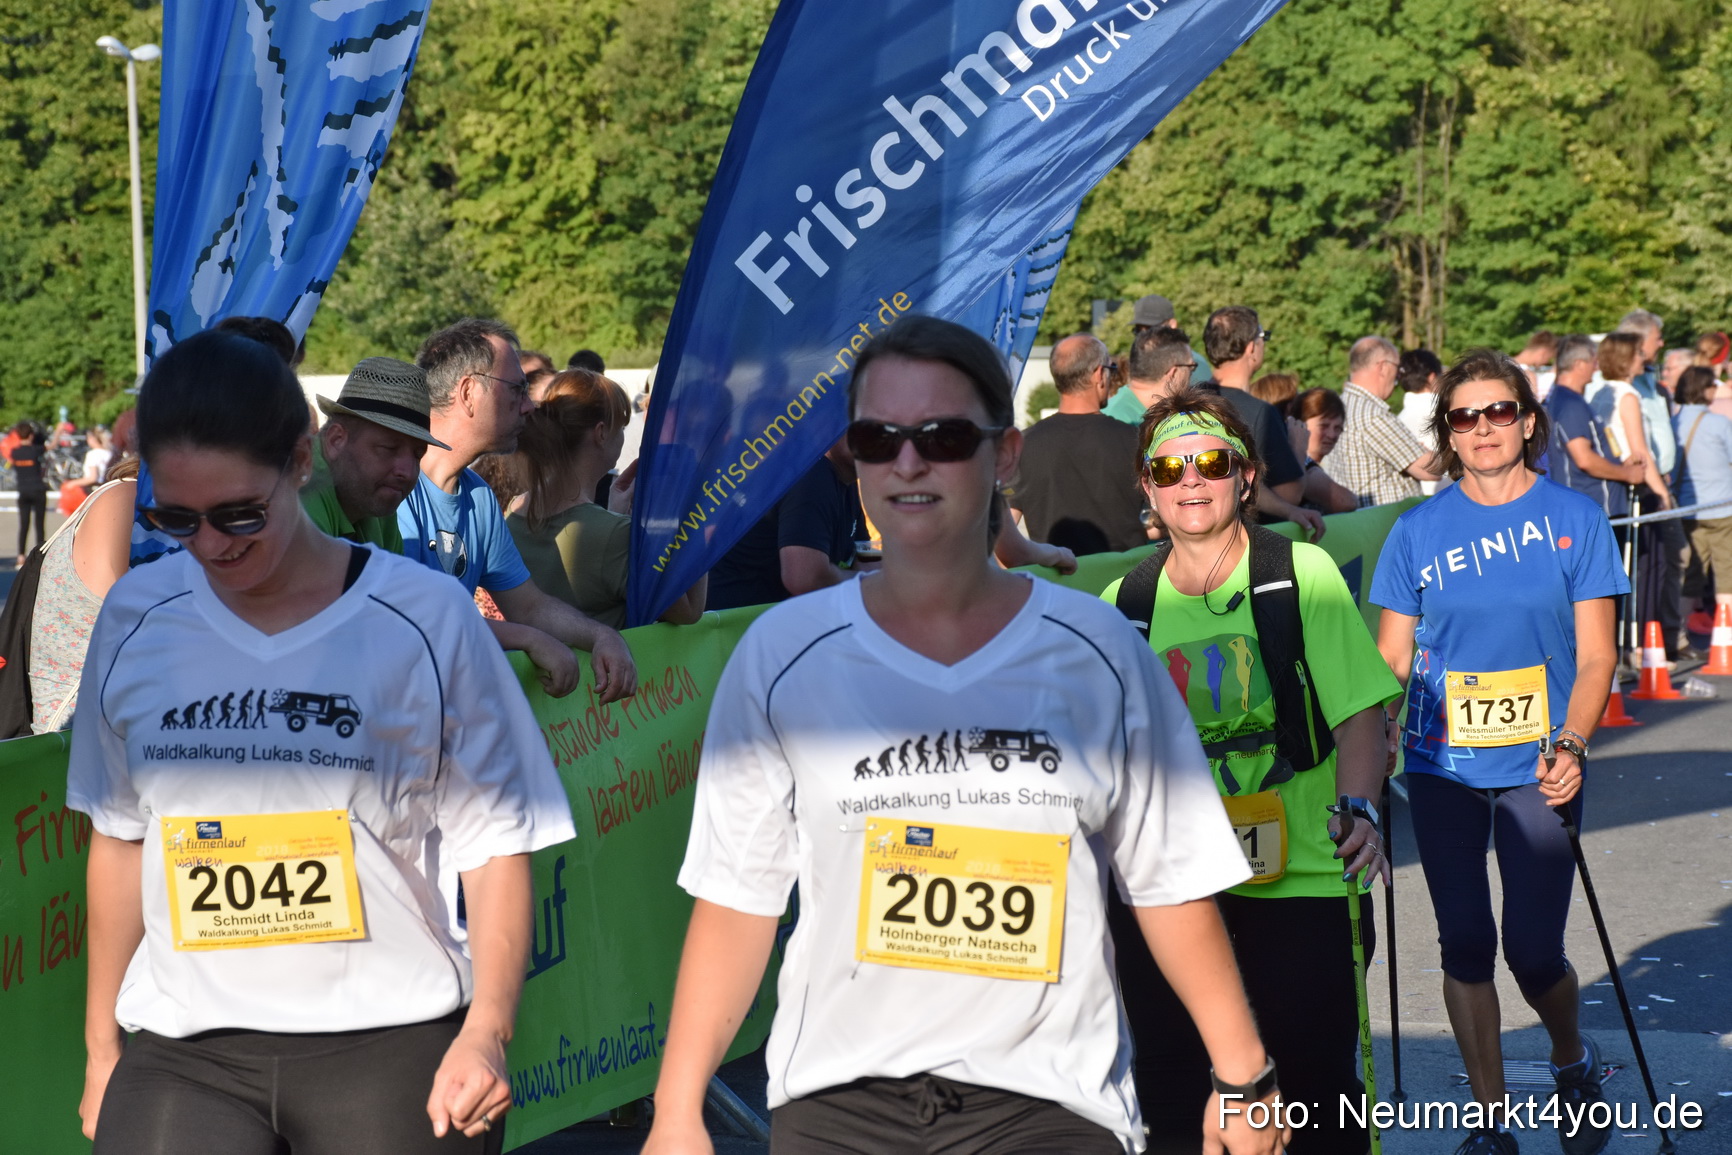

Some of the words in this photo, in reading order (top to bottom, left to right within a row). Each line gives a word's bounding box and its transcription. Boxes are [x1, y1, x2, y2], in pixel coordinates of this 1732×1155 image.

[1021, 20, 1131, 122] Druck
[1126, 0, 1168, 21] u
[734, 0, 1098, 315] Frischma
[652, 291, 912, 572] www.frischmann-net.de
[1460, 694, 1534, 726] 1737
[1458, 726, 1506, 734] Weissmüller
[1508, 721, 1540, 732] Theresia
[143, 743, 246, 763] Waldkalkung
[251, 744, 303, 762] Lukas
[308, 748, 375, 772] Schmidt
[587, 757, 658, 838] laufen
[837, 791, 950, 815] Waldkalkung
[957, 788, 1010, 805] Lukas
[186, 836, 248, 849] firmenlauf
[890, 842, 959, 860] firmenlauf
[188, 860, 331, 912] 2042
[213, 913, 271, 927] Schmidt
[276, 909, 315, 922] Linda
[883, 874, 1035, 936] 2039
[198, 927, 259, 938] Waldkalkung
[261, 925, 290, 935] Lukas
[293, 921, 333, 932] Schmidt
[879, 926, 963, 950] Holnberger
[968, 936, 1037, 953] Natascha
[886, 941, 950, 958] Waldkalkung
[953, 945, 983, 961] Lukas
[986, 952, 1028, 965] Schmidt
